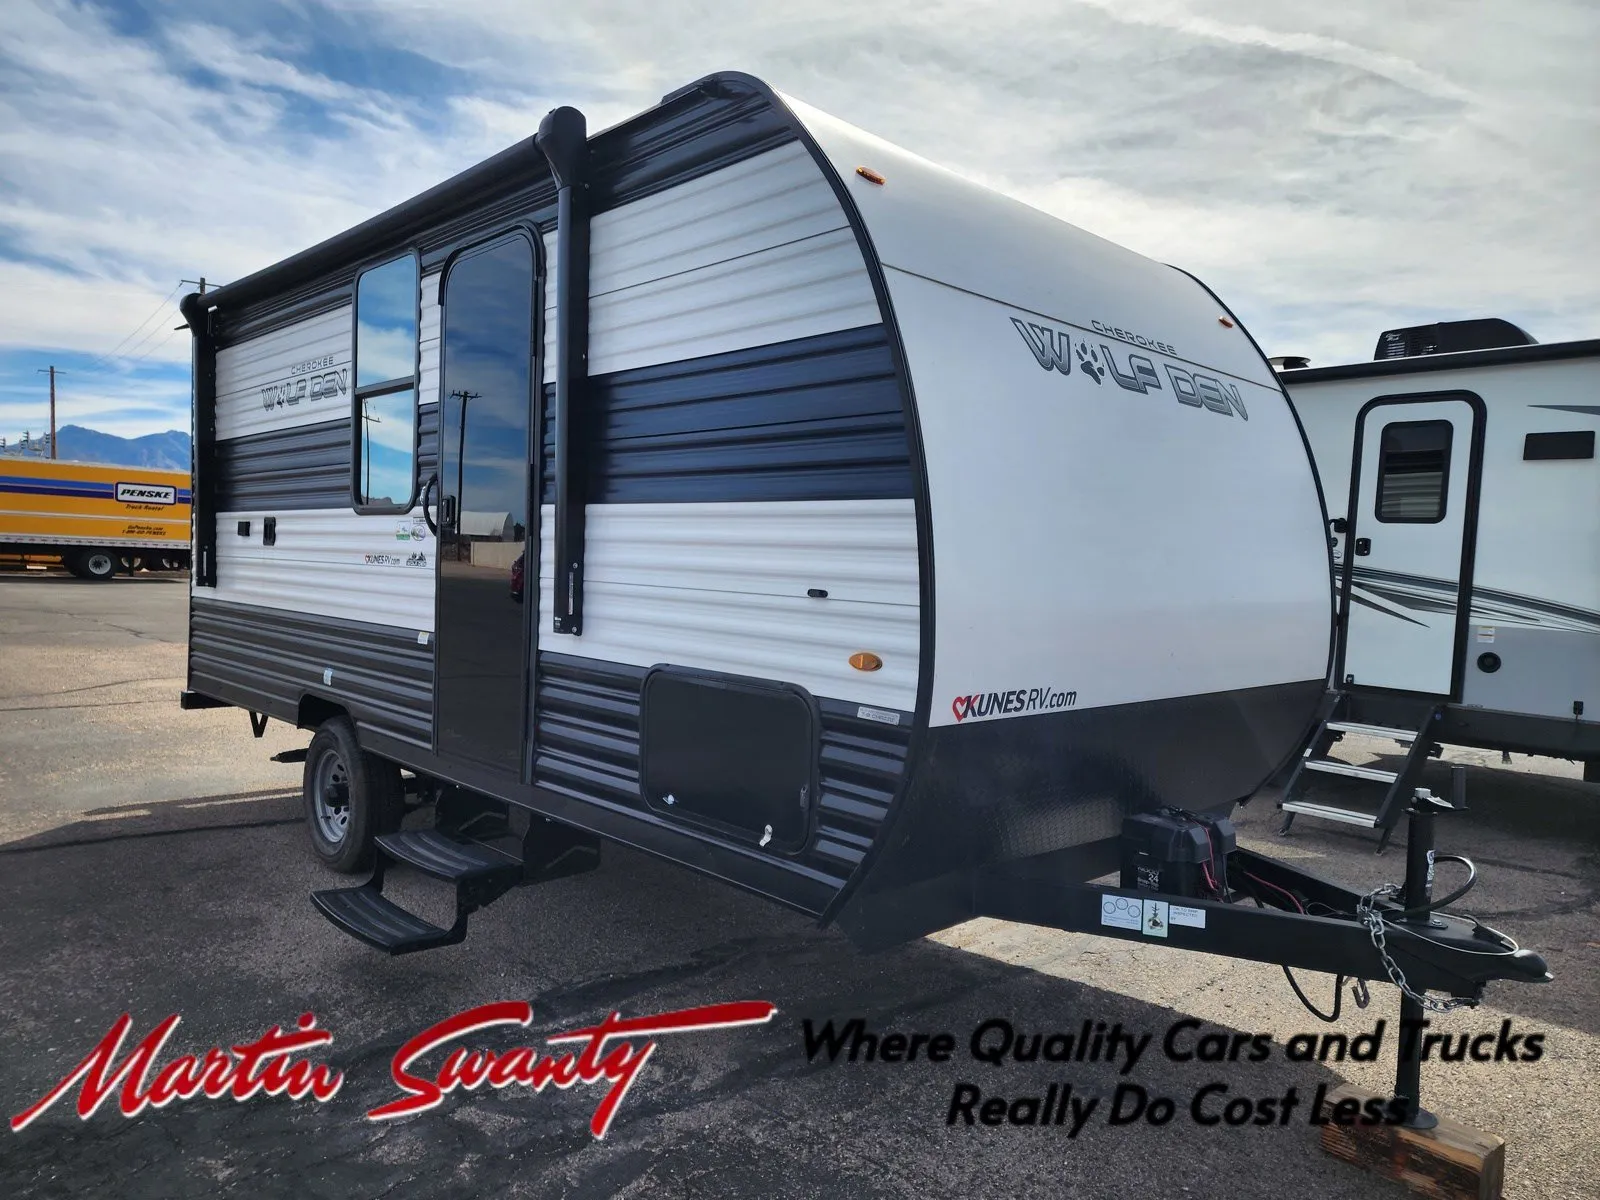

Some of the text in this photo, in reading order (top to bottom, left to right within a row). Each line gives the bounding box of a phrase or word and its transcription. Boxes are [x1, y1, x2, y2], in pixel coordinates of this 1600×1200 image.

[1091, 319, 1178, 355] CHEROKEE
[290, 356, 334, 375] CHEROKEE
[310, 368, 348, 402] DEN
[1163, 362, 1249, 421] DEN
[120, 489, 172, 498] PENSKE
[1148, 873, 1159, 883] 24
